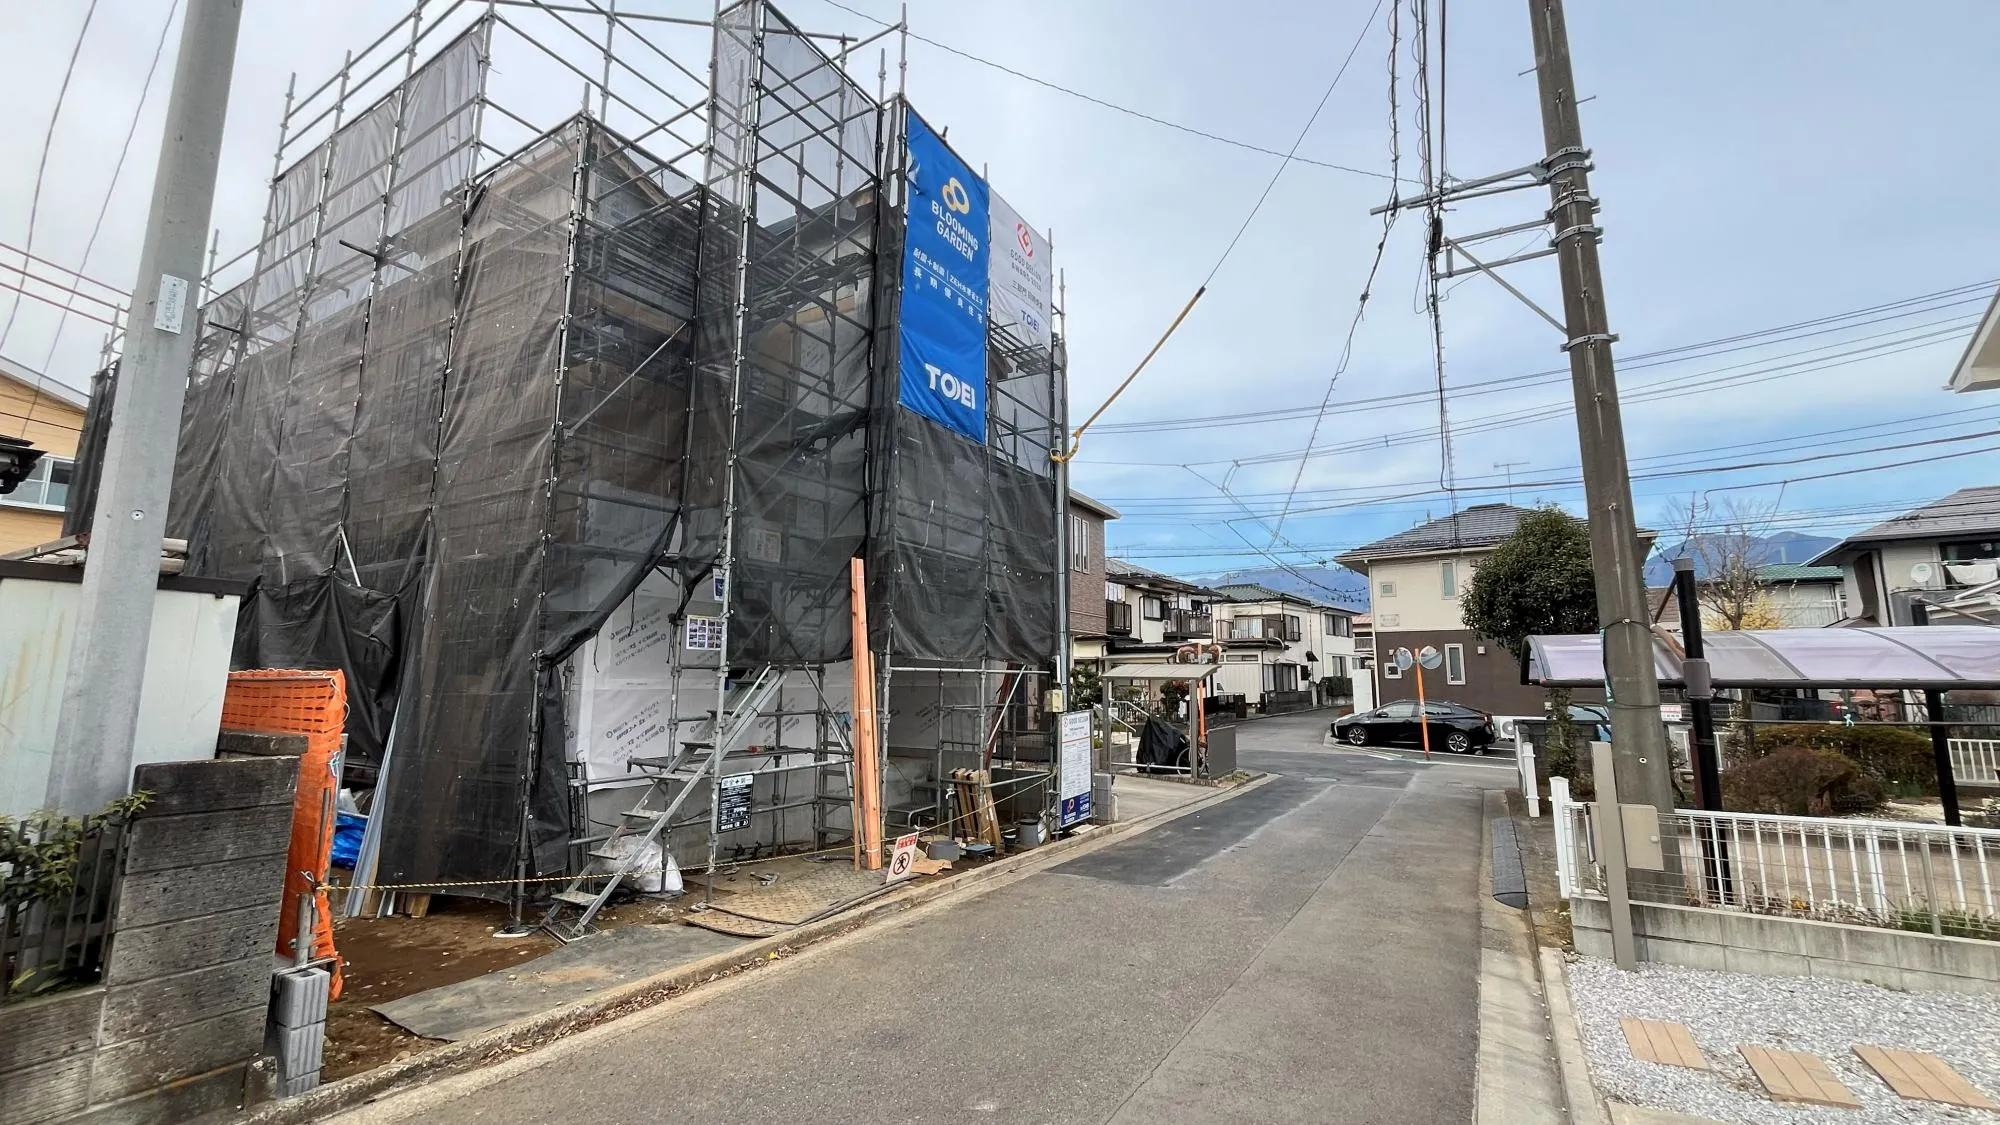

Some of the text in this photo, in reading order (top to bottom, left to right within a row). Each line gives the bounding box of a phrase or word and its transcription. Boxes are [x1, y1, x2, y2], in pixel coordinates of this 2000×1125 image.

[931, 199, 979, 251] BLOOMING
[936, 221, 974, 263] GARDEN
[1020, 310, 1040, 333] TOEI
[925, 363, 976, 410] TOEI
